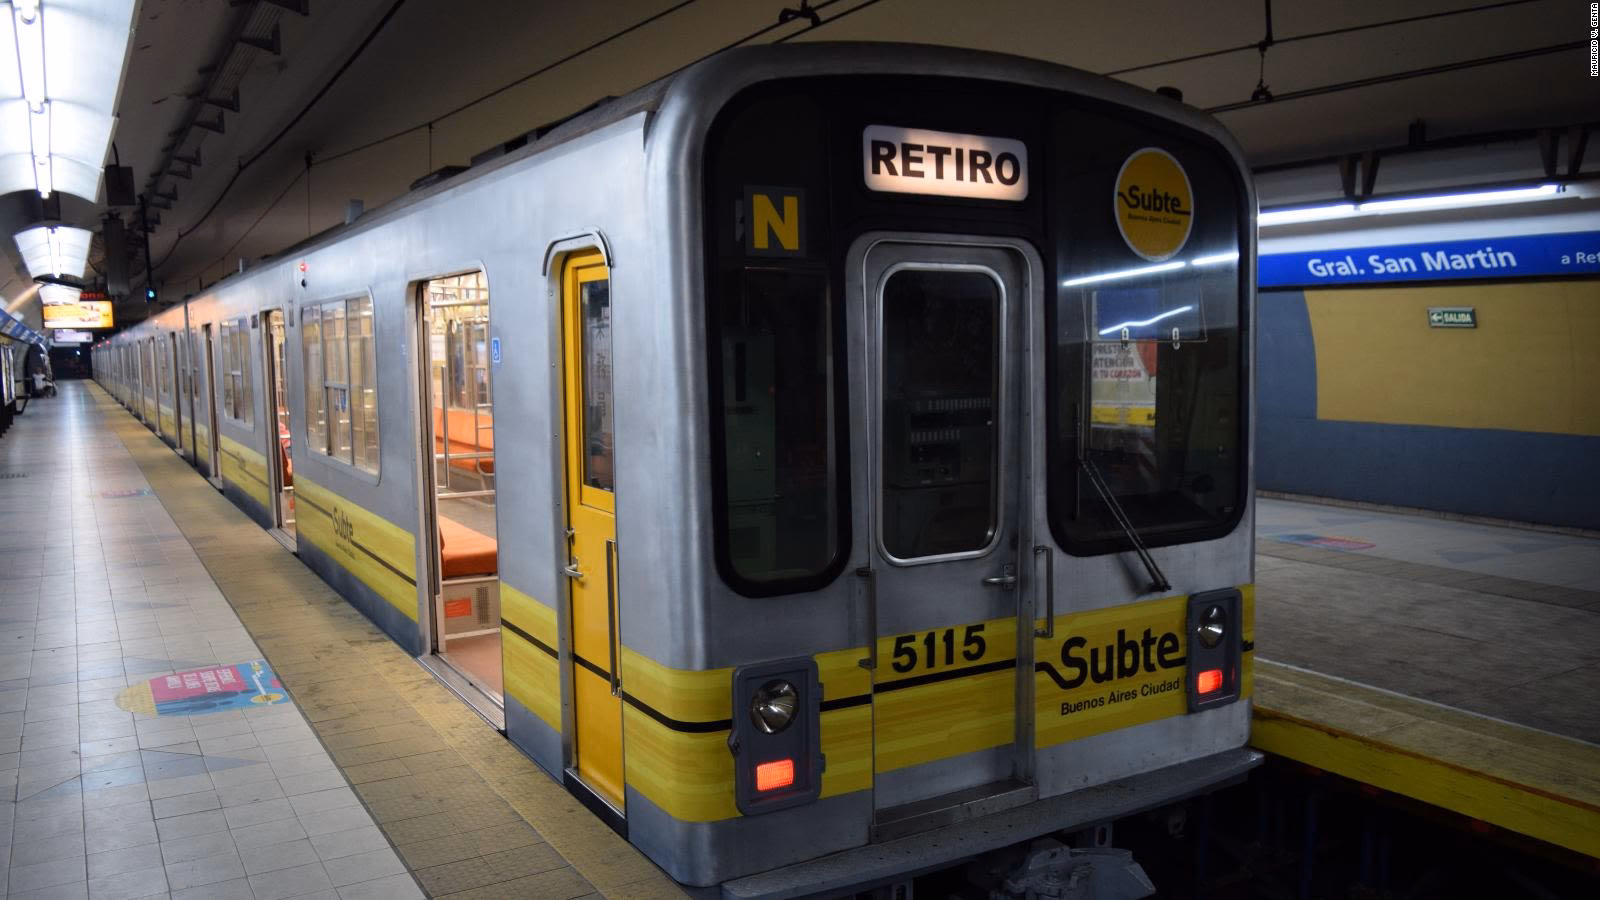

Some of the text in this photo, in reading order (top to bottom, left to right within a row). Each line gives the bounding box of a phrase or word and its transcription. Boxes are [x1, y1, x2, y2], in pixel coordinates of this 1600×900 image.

[871, 139, 1021, 186] RETIRO
[1121, 185, 1186, 215] Subte
[753, 194, 799, 250] N
[1307, 256, 1365, 277] Gral.
[1368, 254, 1418, 275] San
[1561, 255, 1571, 265] a
[1444, 312, 1473, 323] SALIDA
[892, 624, 986, 673] 5115
[1046, 628, 1186, 690] Subte
[1061, 678, 1180, 715] Buenos Aires Ciudad
